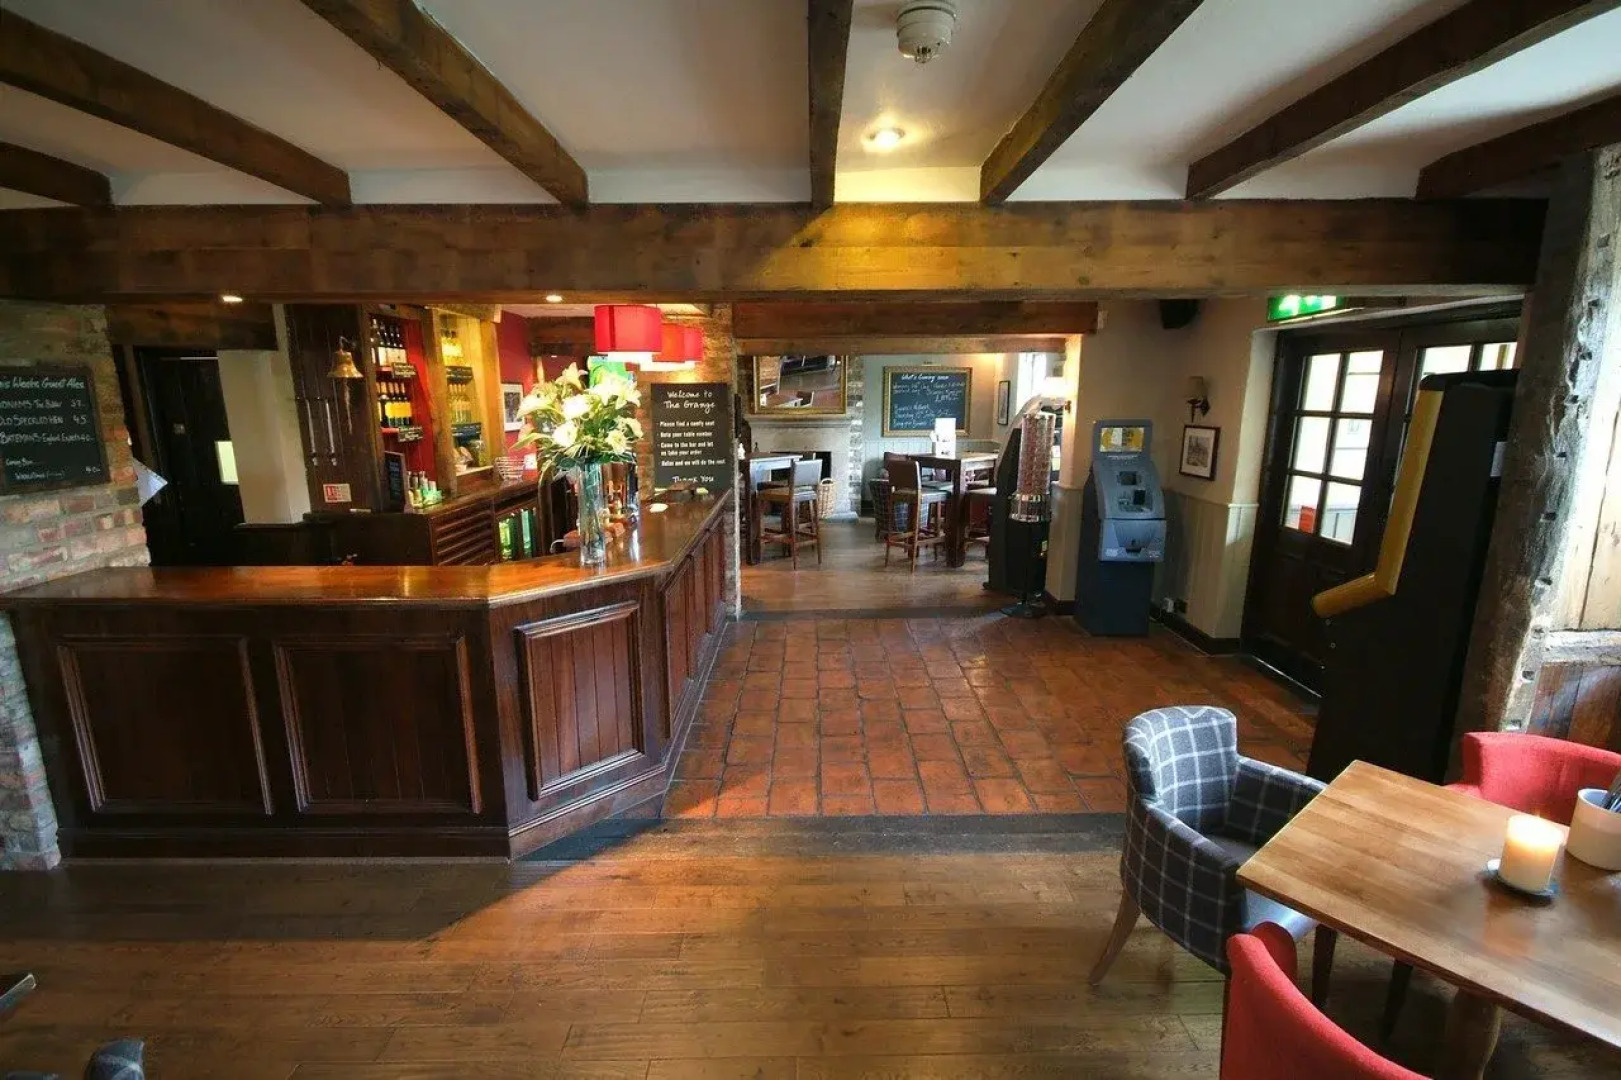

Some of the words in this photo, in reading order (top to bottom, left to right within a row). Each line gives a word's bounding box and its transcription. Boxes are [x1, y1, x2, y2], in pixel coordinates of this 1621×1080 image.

[667, 389, 700, 399] Welcome
[703, 390, 713, 398] to
[664, 400, 680, 409] The
[683, 400, 716, 414] Grange
[672, 475, 698, 483] Thank
